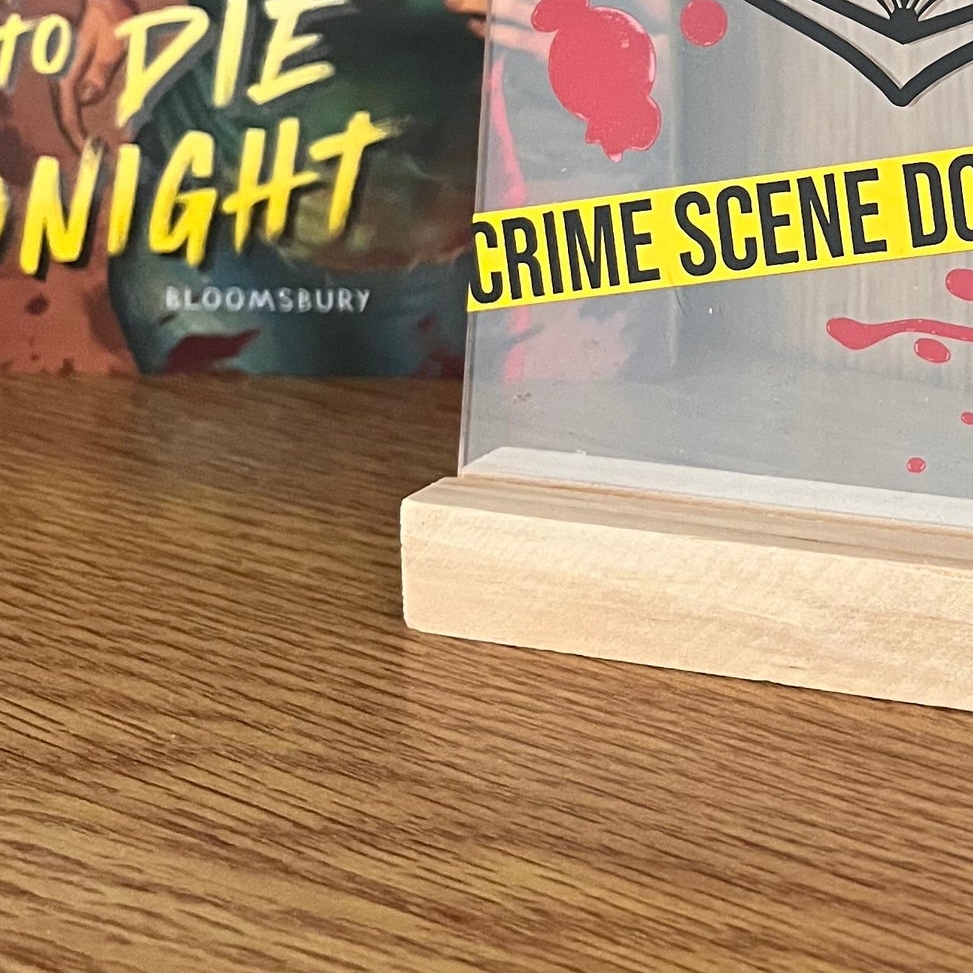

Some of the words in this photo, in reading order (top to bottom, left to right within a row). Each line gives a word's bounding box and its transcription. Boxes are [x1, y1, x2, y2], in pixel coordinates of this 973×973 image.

[0, 111, 400, 275] NIGHT
[472, 198, 661, 304] CRIME
[673, 167, 888, 279] SCENE
[165, 285, 371, 314] BLOOMSBURY
